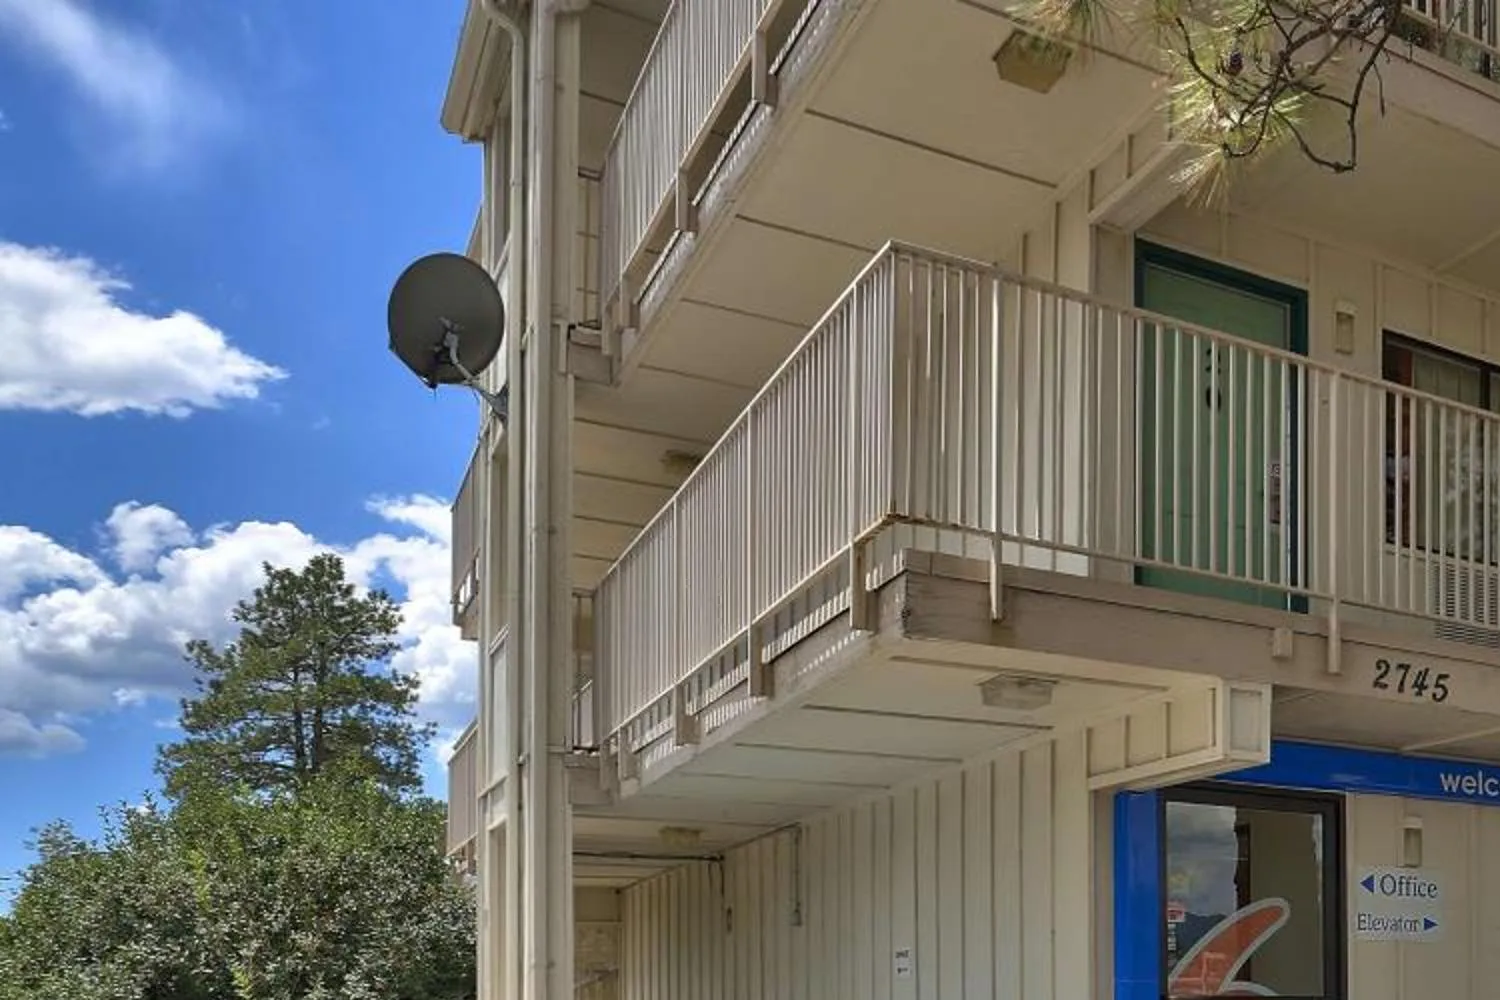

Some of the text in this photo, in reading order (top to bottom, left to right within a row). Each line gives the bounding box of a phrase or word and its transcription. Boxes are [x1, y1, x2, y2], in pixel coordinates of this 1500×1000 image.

[1373, 659, 1450, 702] 2745
[1380, 874, 1438, 898] Office
[1357, 913, 1419, 932] Elevator
